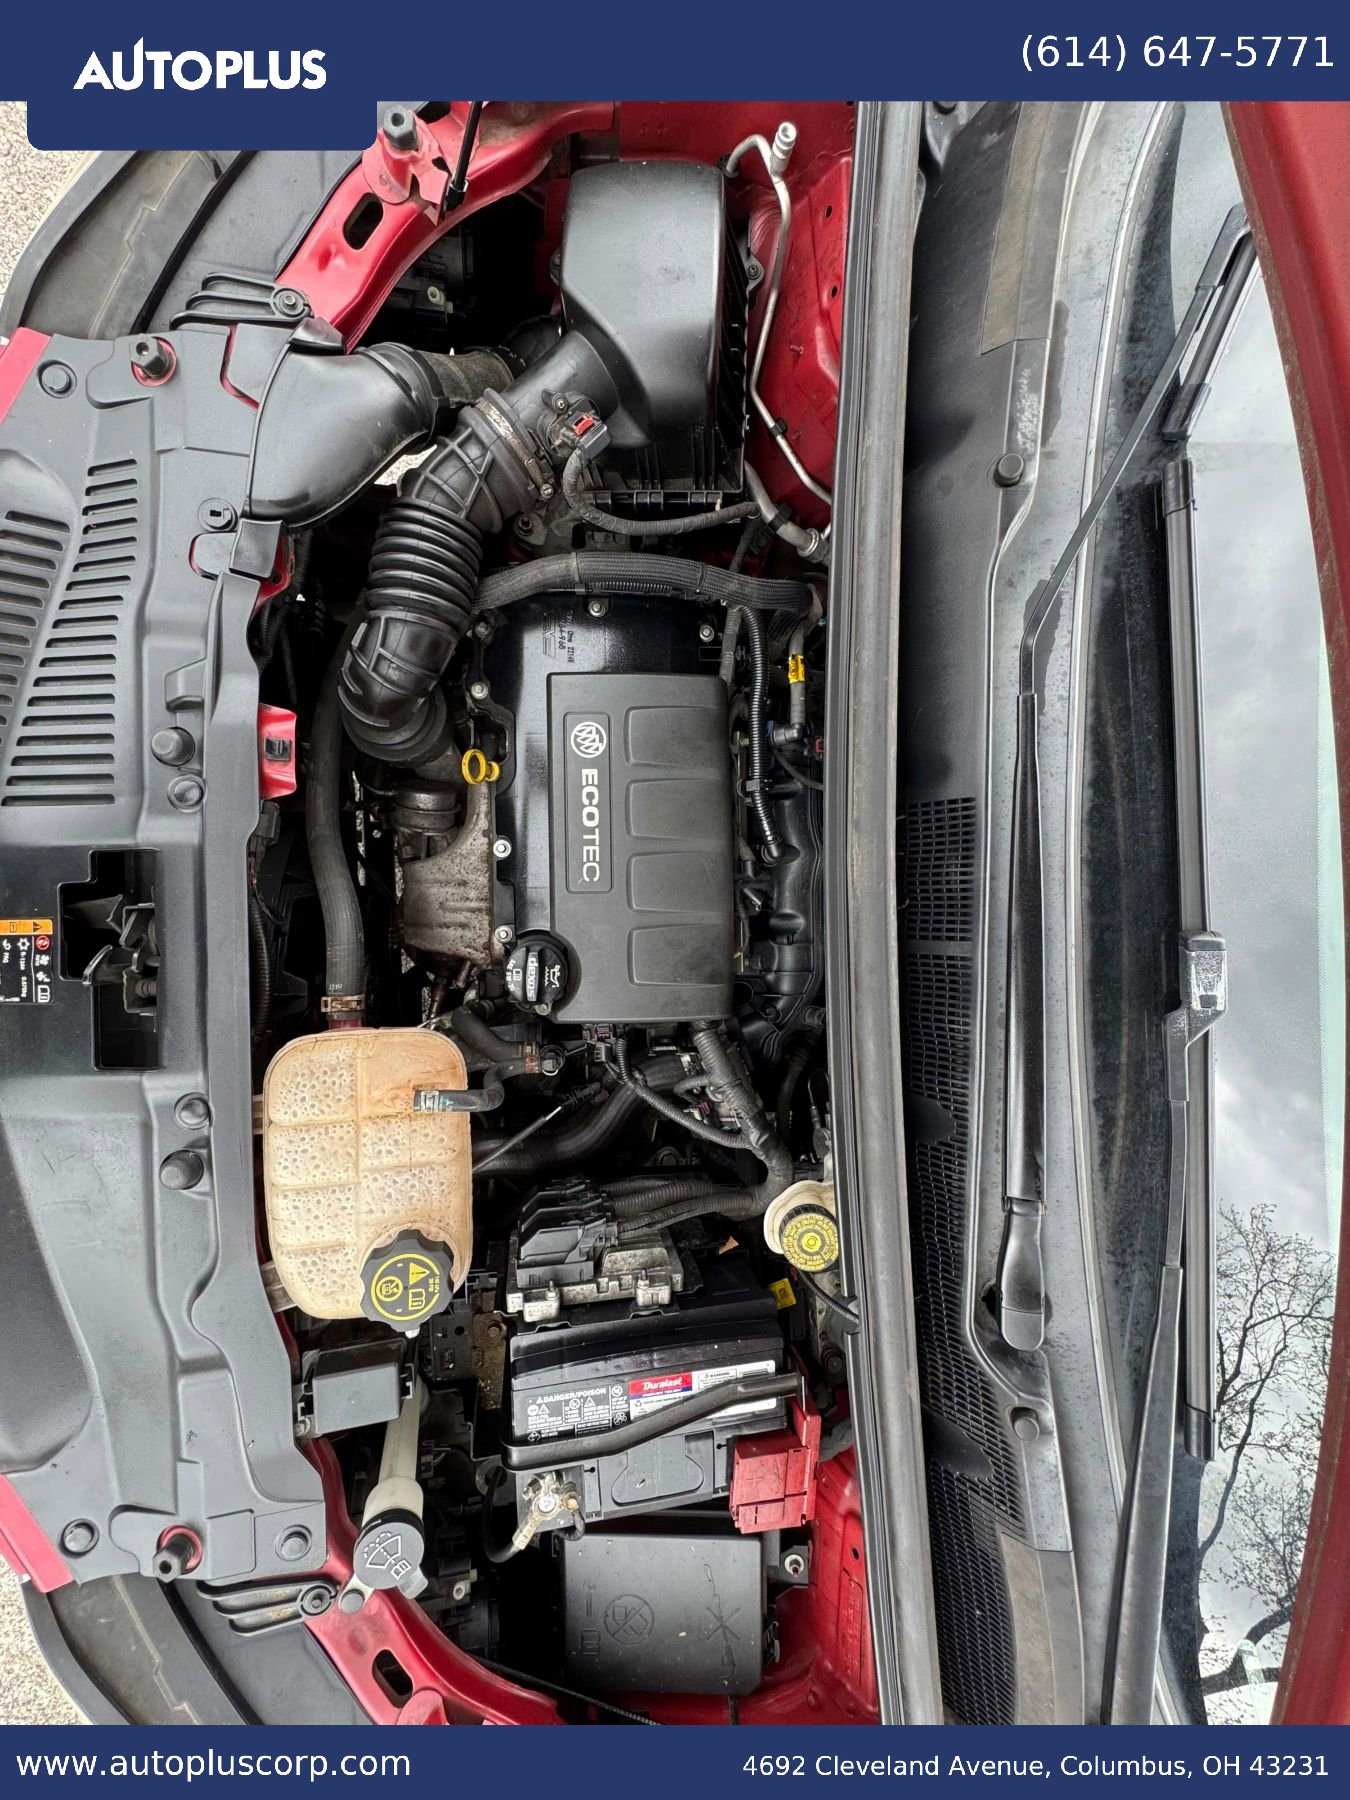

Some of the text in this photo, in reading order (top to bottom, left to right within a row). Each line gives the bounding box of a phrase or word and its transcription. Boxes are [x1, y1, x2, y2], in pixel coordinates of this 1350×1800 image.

[580, 768, 600, 882] ECOTEC
[528, 957, 539, 999] dexos
[543, 1387, 607, 1403] DANGER/POISON
[642, 1376, 682, 1391] Duralast
